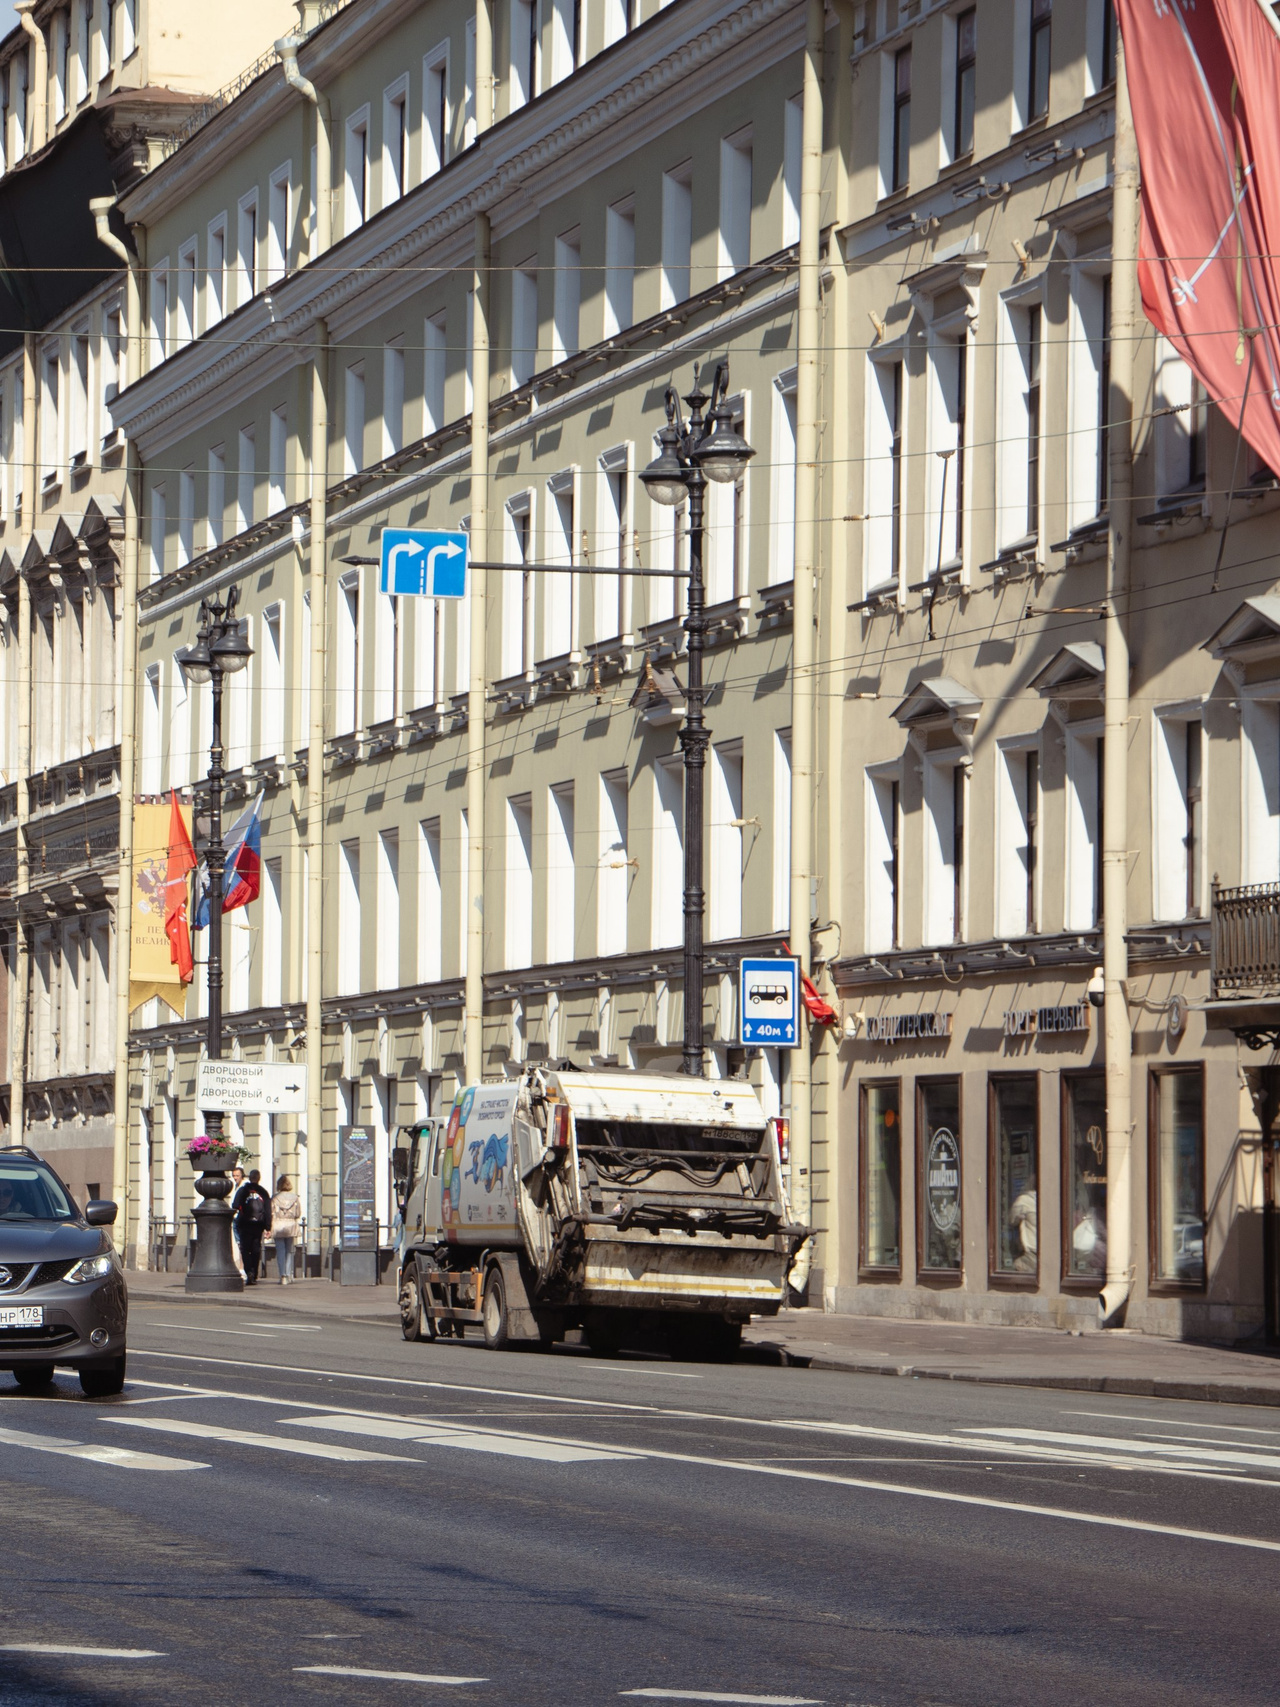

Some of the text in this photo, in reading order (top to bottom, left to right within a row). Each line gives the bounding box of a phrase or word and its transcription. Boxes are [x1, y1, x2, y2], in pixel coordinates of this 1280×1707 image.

[147, 925, 166, 934] ПЕТ
[135, 936, 170, 945] ВЕЛИК
[866, 999, 1088, 1045] КОНДИТЕРСКАЯ ТОРТ ПЕРВЫЙ
[202, 1065, 263, 1076] ДВОРЦОВЫЙ
[215, 1076, 249, 1084] проезд
[201, 1088, 263, 1099] ДВОРЦОВЫЙ
[20, 1308, 38, 1318] 178
